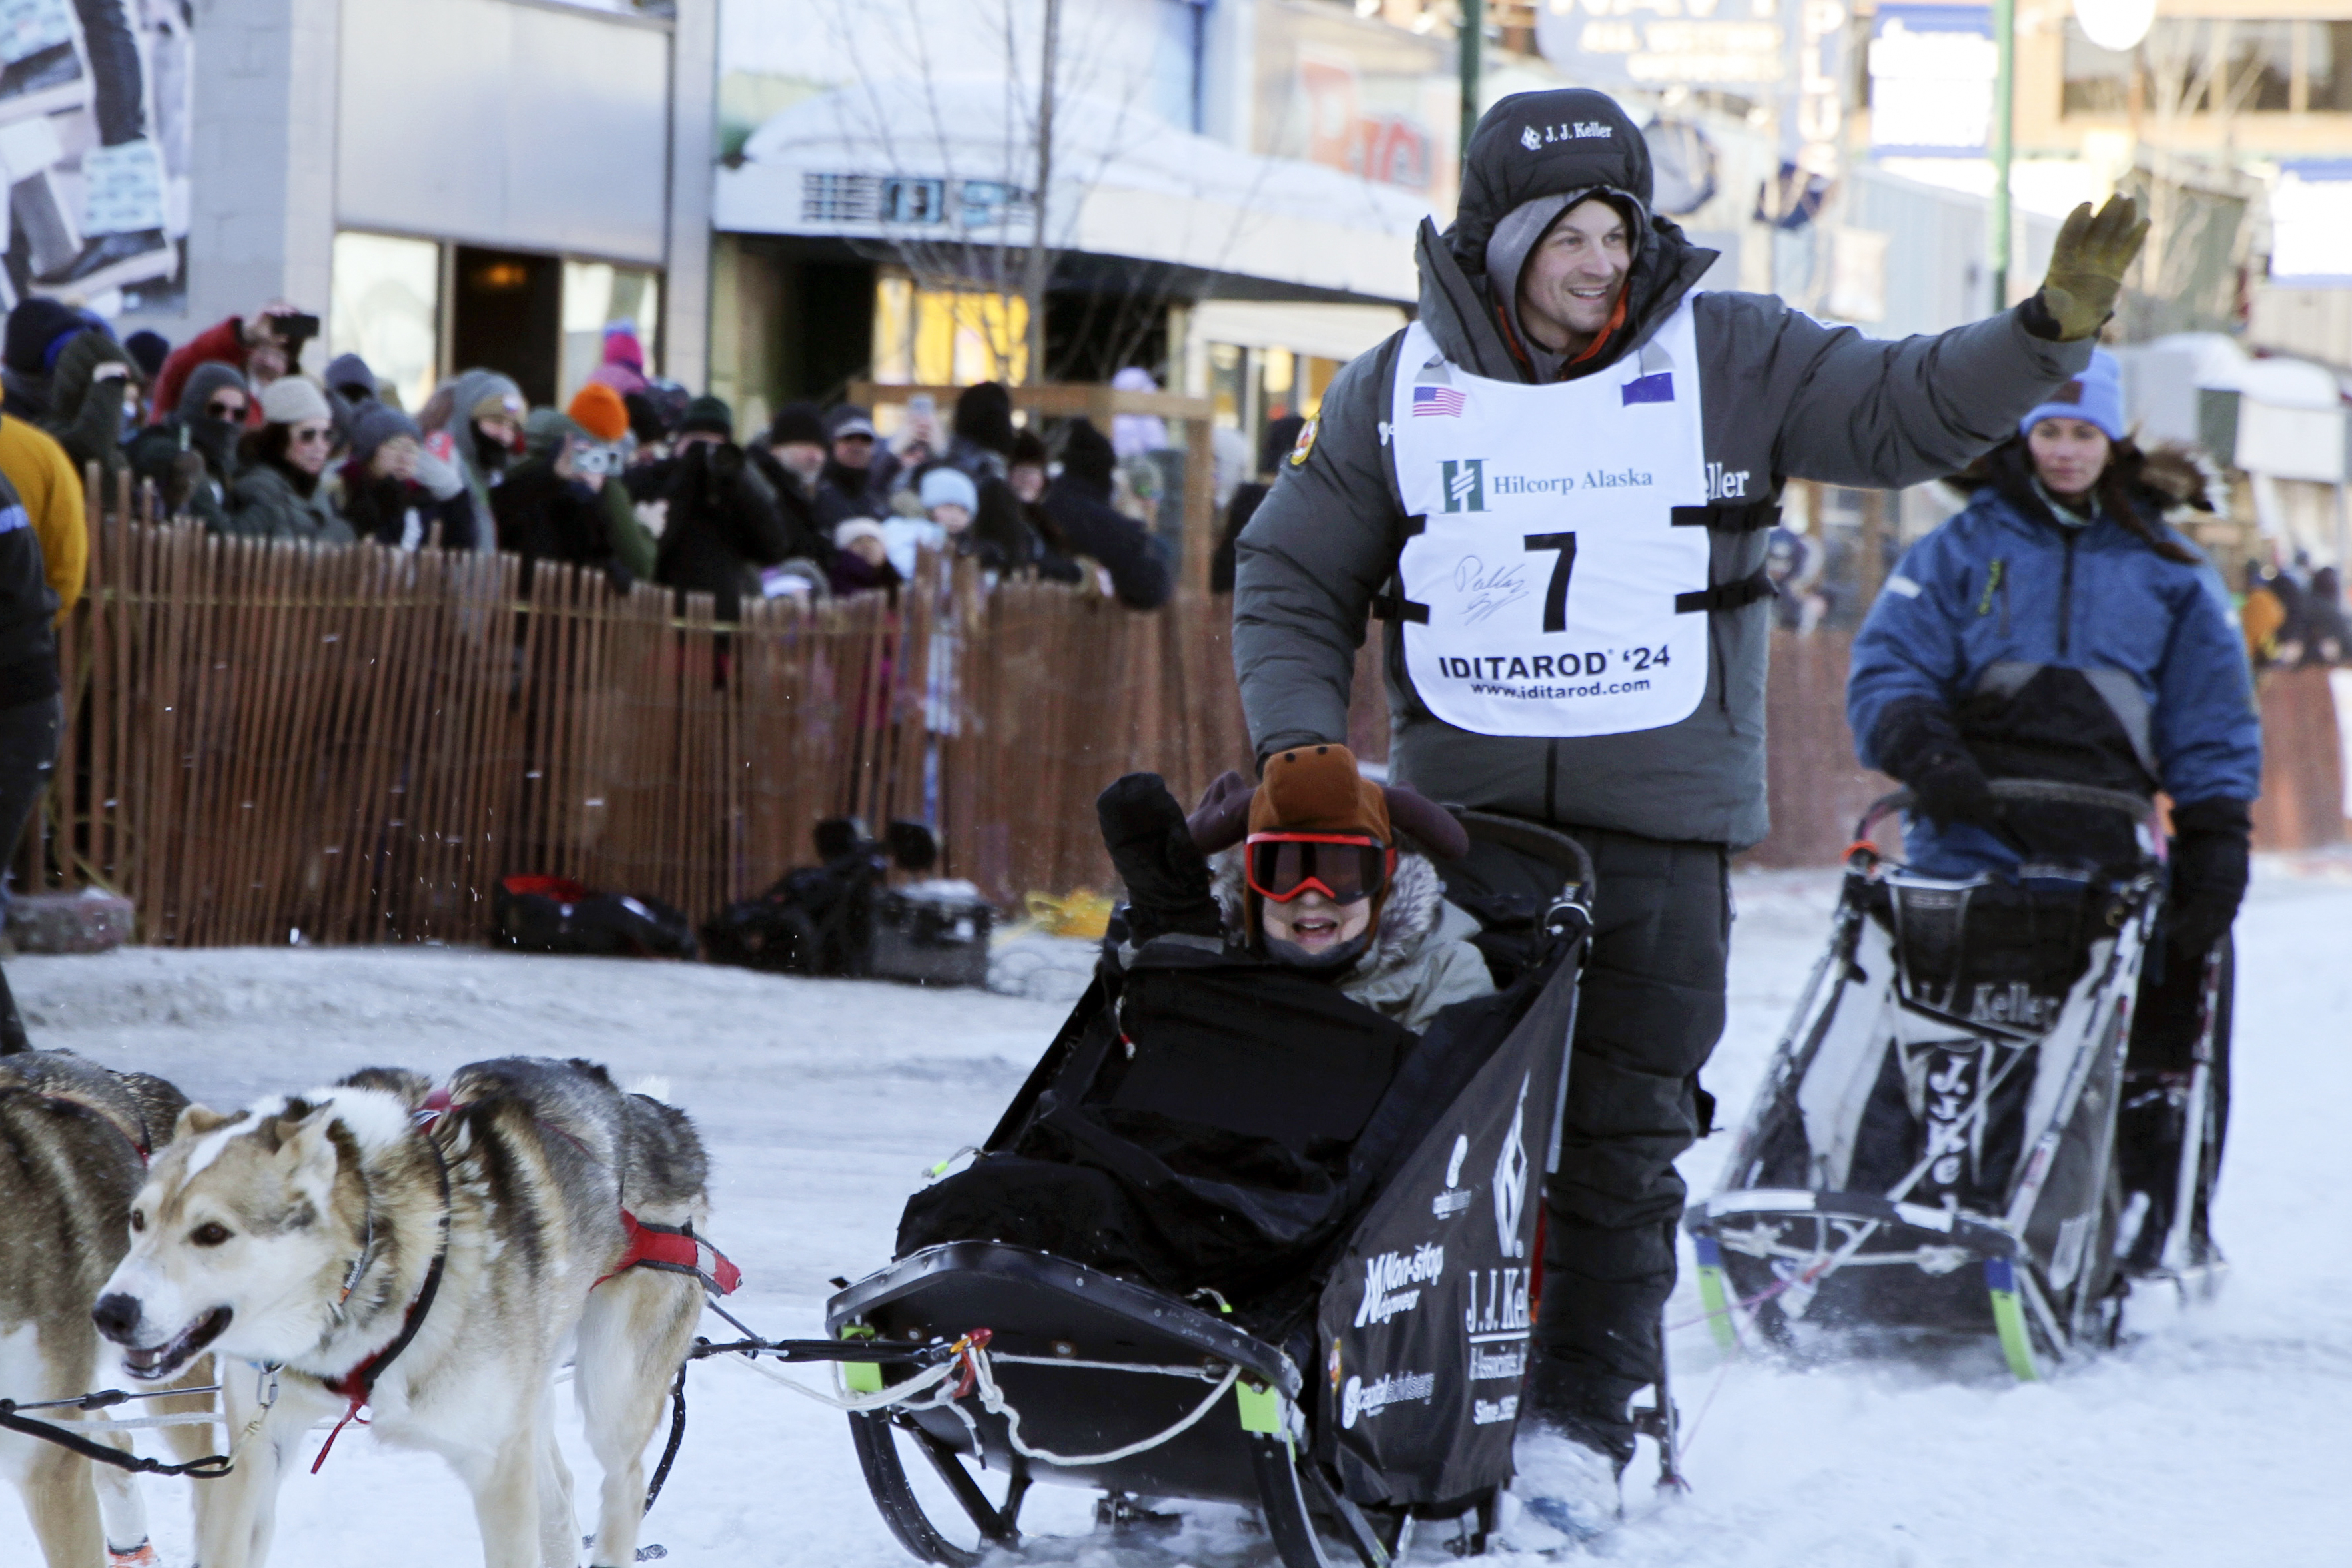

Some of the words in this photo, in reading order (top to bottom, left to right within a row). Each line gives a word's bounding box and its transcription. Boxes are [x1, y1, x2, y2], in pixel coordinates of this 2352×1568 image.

[1545, 126, 1559, 143] J.
[1560, 123, 1573, 141] J.
[1573, 121, 1613, 138] Keller
[1493, 474, 1574, 496] Hilcorp
[1581, 468, 1653, 490] Alaska
[1705, 460, 1750, 500] ller
[1523, 531, 1577, 633] 7
[1439, 651, 1607, 680] IDITAROD
[1470, 679, 1651, 700] www.iditarod.com
[1466, 1270, 1484, 1333] J.
[1485, 1268, 1499, 1331] J.
